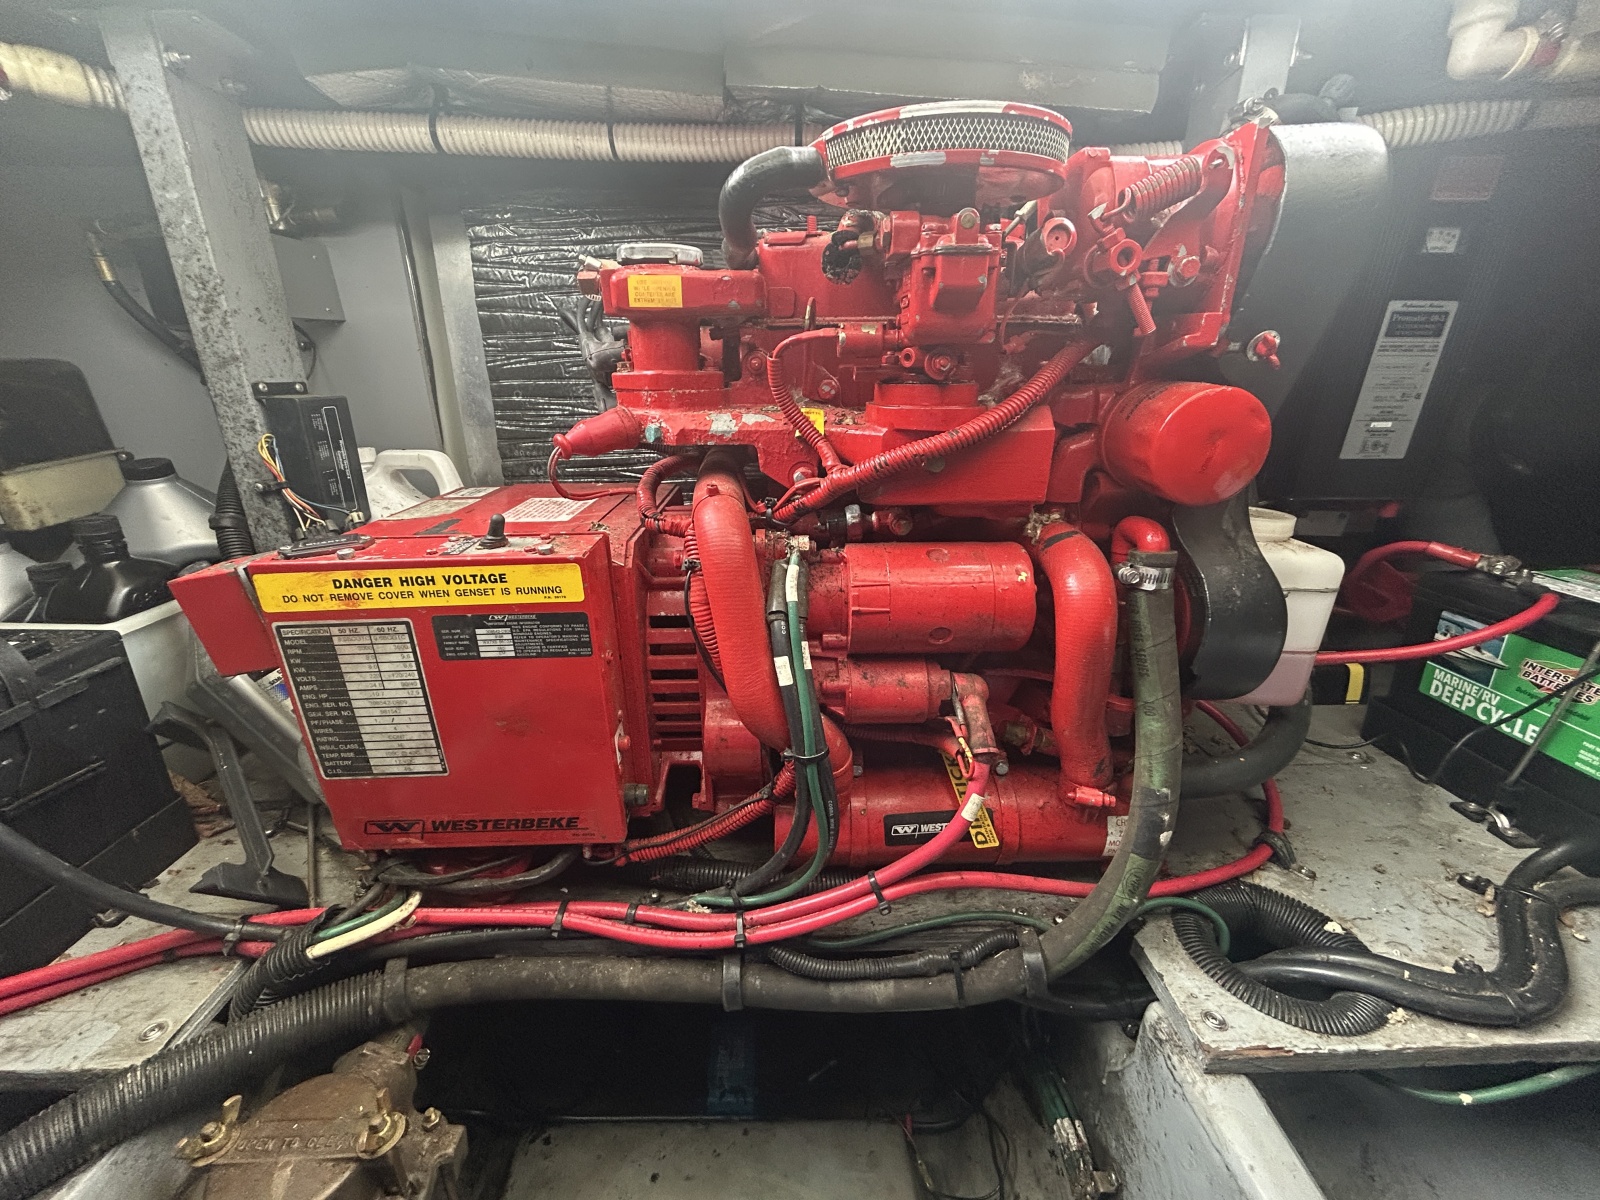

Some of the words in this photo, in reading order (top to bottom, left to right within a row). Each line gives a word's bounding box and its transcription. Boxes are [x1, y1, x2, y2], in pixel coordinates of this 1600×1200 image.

[332, 577, 392, 589] DANGER
[399, 575, 436, 587] HIGH
[442, 573, 508, 585] VOLTAGE
[282, 594, 298, 604] DO
[303, 594, 324, 602] NOT
[330, 592, 374, 602] REMOVE
[378, 590, 414, 600] COVER
[418, 589, 450, 598] WHEN
[454, 588, 496, 597] GENSET
[501, 587, 511, 596] IS
[516, 586, 562, 595] RUNNING
[1134, 648, 1150, 678] SERIES
[1433, 668, 1500, 706] MARINE/RV
[1522, 670, 1594, 704] BATTEES
[1523, 660, 1600, 696] INTERSATE
[1429, 680, 1476, 712] DEEP
[1476, 701, 1540, 744] CYCLE
[431, 816, 580, 832] WESTERBEKE
[920, 823, 950, 832] WEST
[282, 1137, 300, 1149] TO
